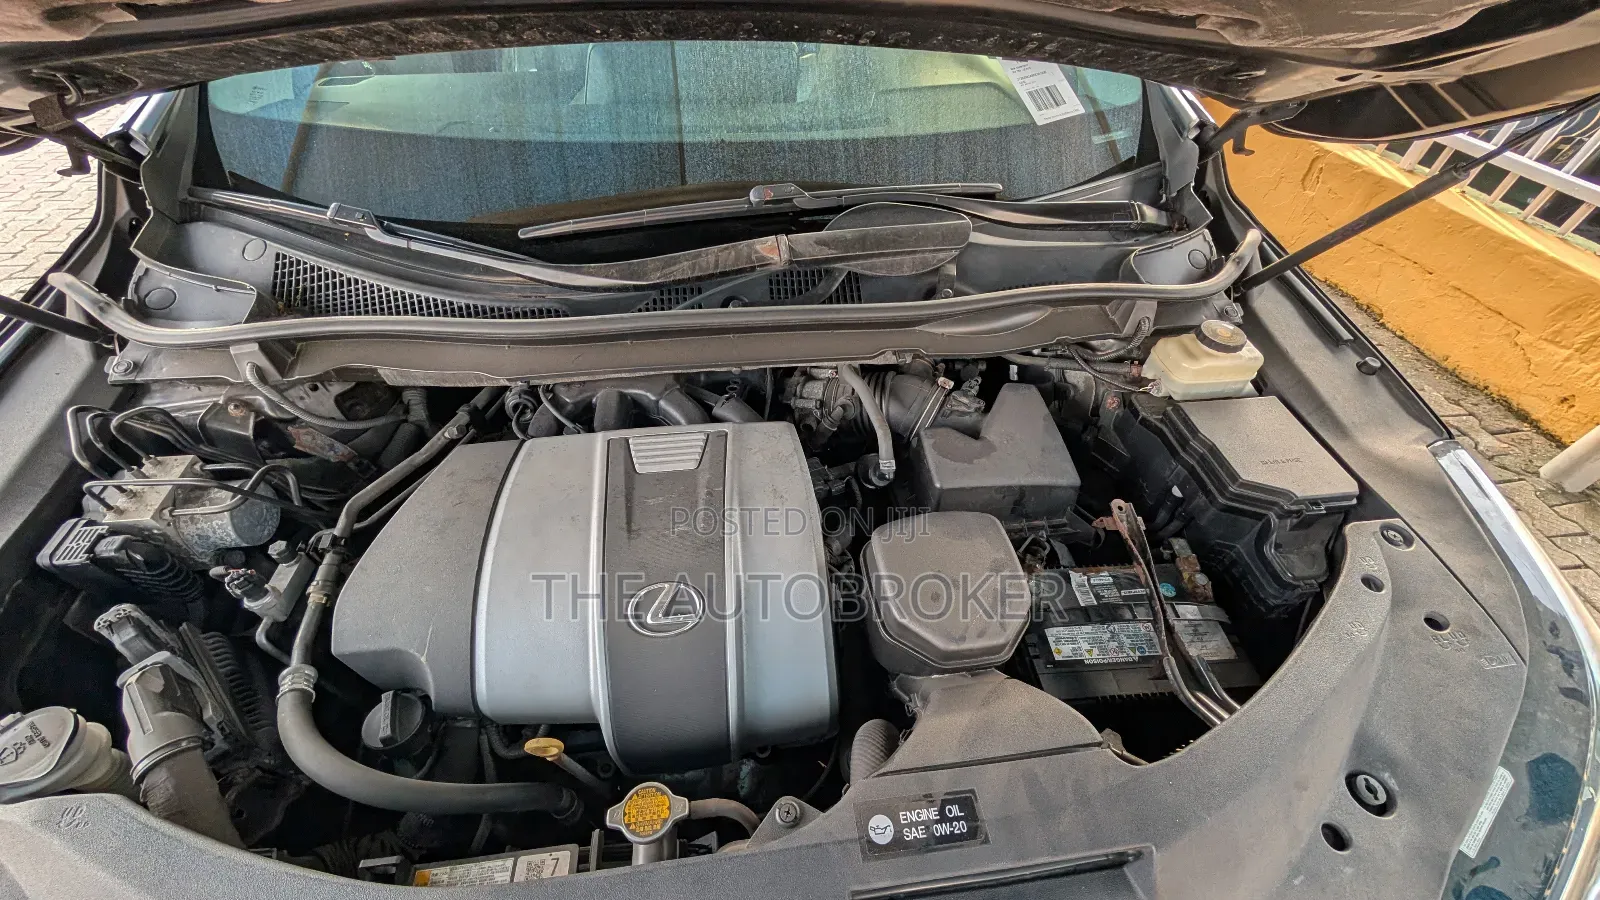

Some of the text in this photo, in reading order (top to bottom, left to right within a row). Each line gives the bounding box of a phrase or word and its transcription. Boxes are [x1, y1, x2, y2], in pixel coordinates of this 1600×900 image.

[899, 804, 965, 824] ENGINE OIL
[903, 820, 968, 841] SAE 0W-20
[551, 857, 560, 877] 7
